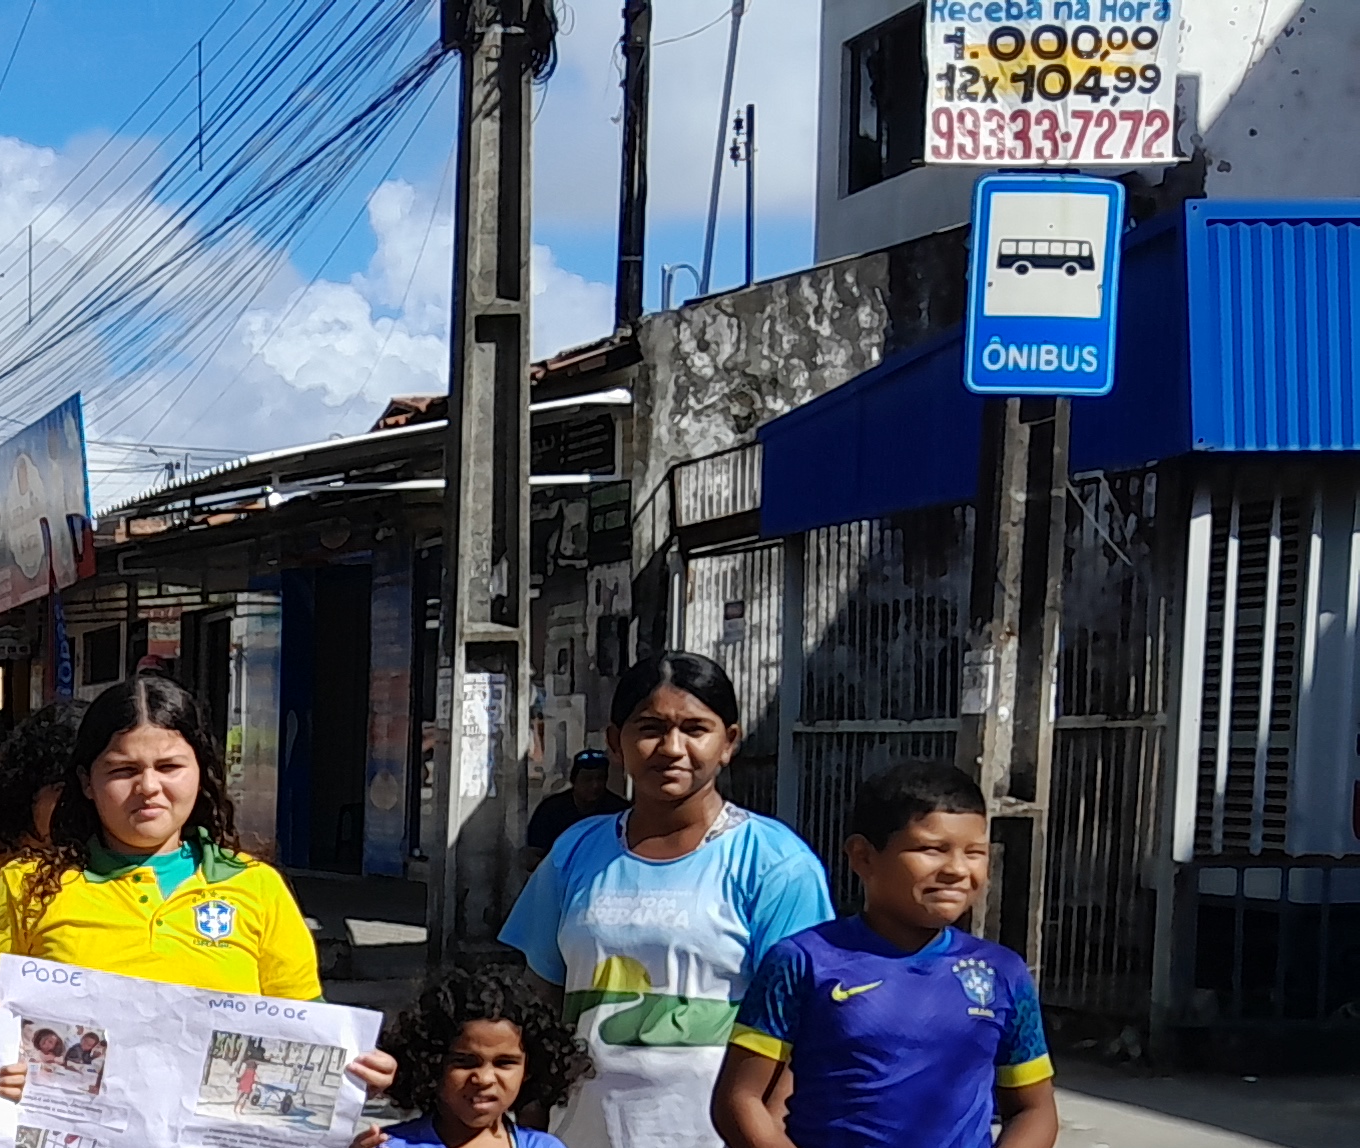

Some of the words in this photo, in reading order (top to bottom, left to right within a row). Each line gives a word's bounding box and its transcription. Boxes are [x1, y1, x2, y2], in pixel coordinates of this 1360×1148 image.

[1054, 0, 1090, 22] na
[1099, 0, 1171, 22] Hora
[936, 62, 999, 103] 12x
[1010, 63, 1161, 107] 104,99
[982, 335, 1098, 373] ÔNIBUS
[21, 960, 83, 987] PODE
[208, 994, 247, 1013] NÃO
